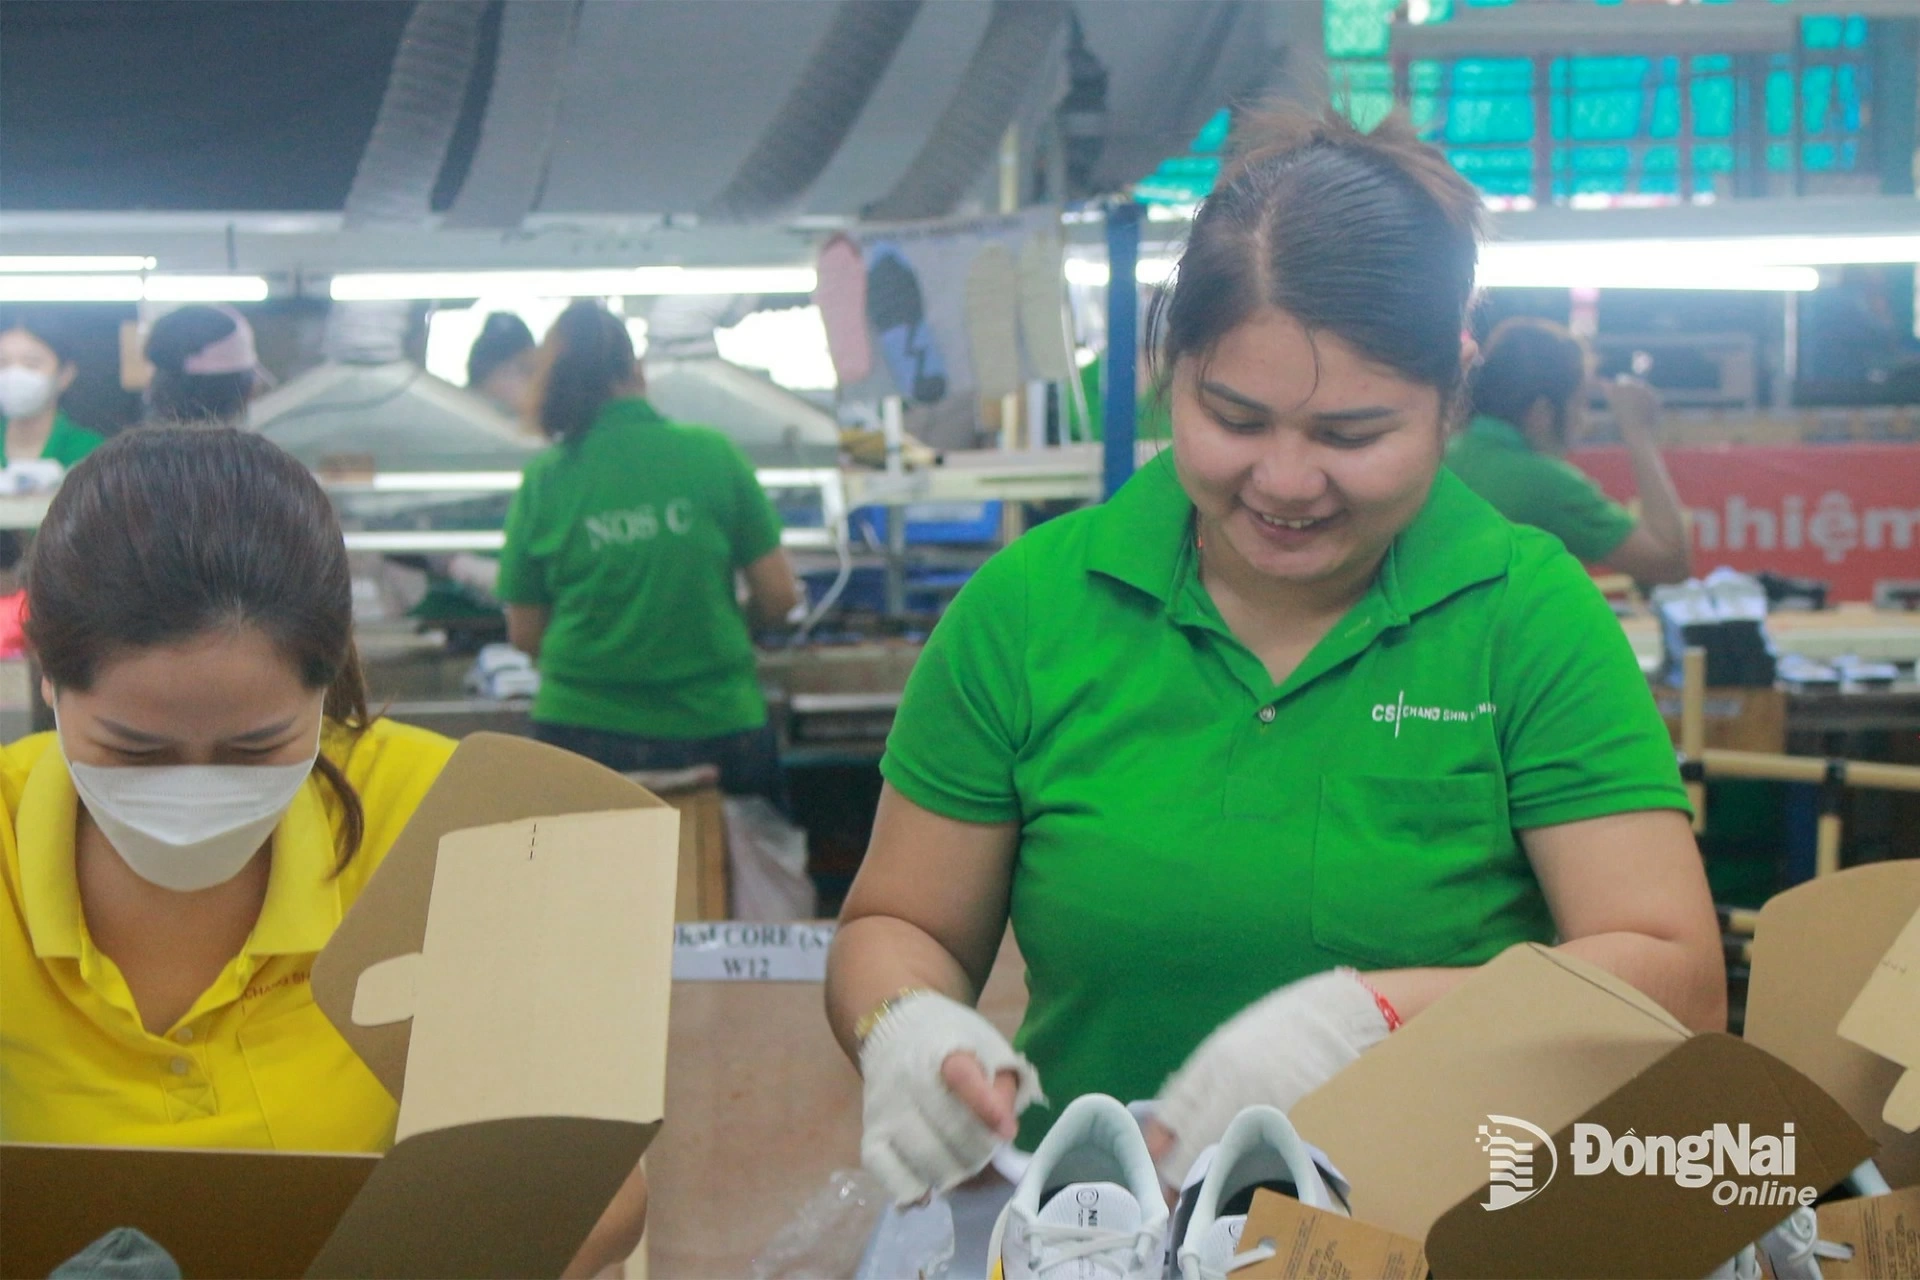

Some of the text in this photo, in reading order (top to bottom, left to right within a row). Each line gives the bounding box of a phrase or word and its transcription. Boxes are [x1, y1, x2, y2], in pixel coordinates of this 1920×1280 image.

[665, 498, 693, 535] C
[1372, 704, 1396, 722] CS
[1443, 709, 1468, 722] SHIN
[723, 957, 770, 978] W12
